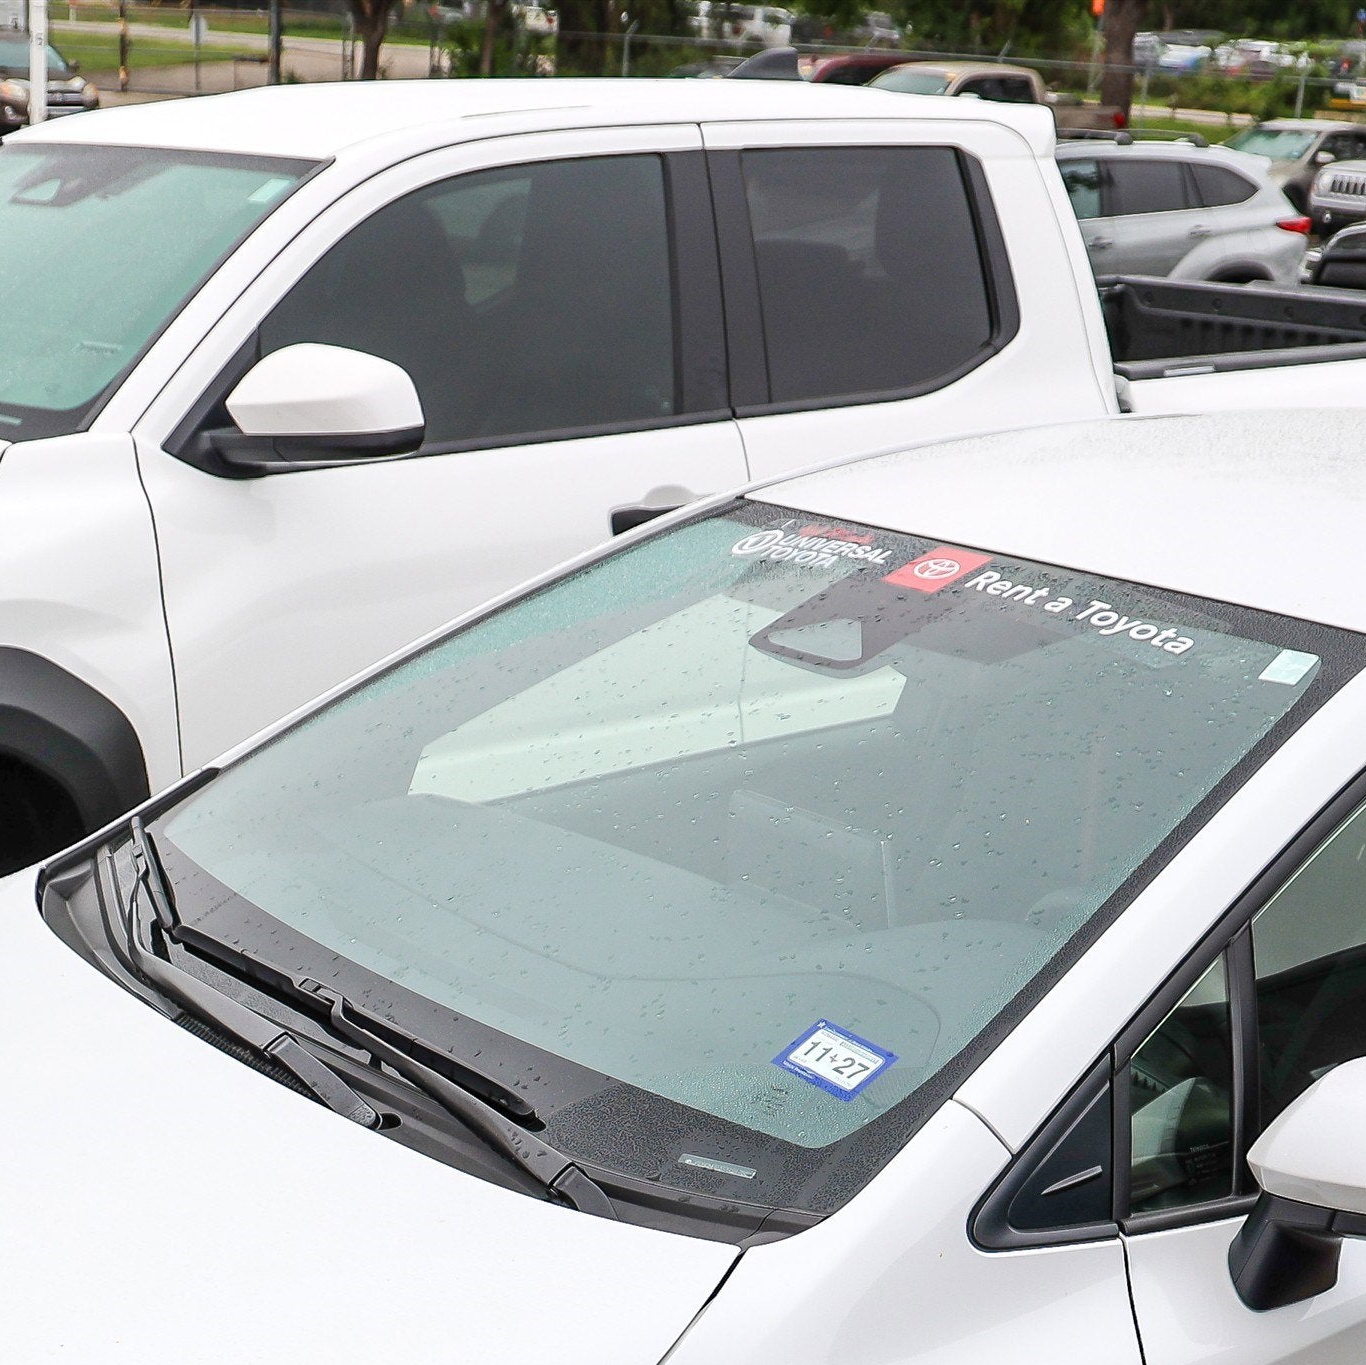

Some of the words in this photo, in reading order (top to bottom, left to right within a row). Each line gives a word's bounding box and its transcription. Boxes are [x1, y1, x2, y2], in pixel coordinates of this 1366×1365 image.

[760, 545, 839, 568] TOYOTA
[777, 533, 893, 565] UNIVERSAL
[964, 570, 1050, 606] Rent
[1044, 596, 1073, 613] a
[1075, 600, 1195, 656] Toyota
